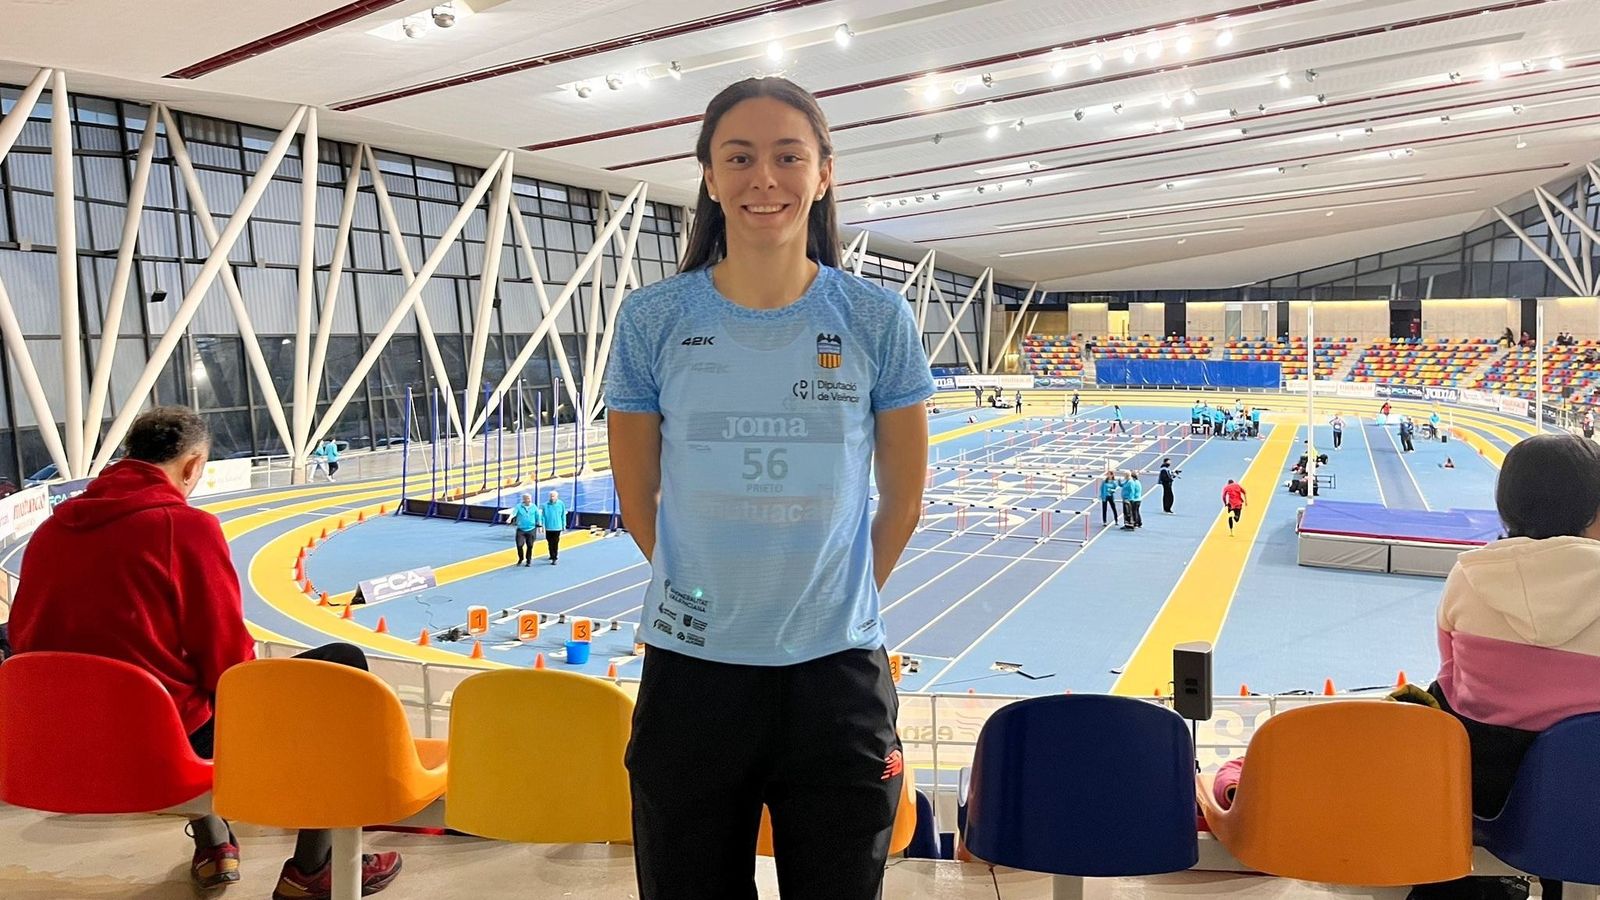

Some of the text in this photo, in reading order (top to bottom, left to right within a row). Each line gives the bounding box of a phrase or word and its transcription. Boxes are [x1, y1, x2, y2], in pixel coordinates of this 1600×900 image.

[681, 336, 716, 346] 42K
[741, 447, 788, 480] 56
[746, 484, 783, 493] PRIETO
[370, 571, 426, 596] FCA
[524, 619, 534, 632] 2
[576, 625, 587, 639] 3
